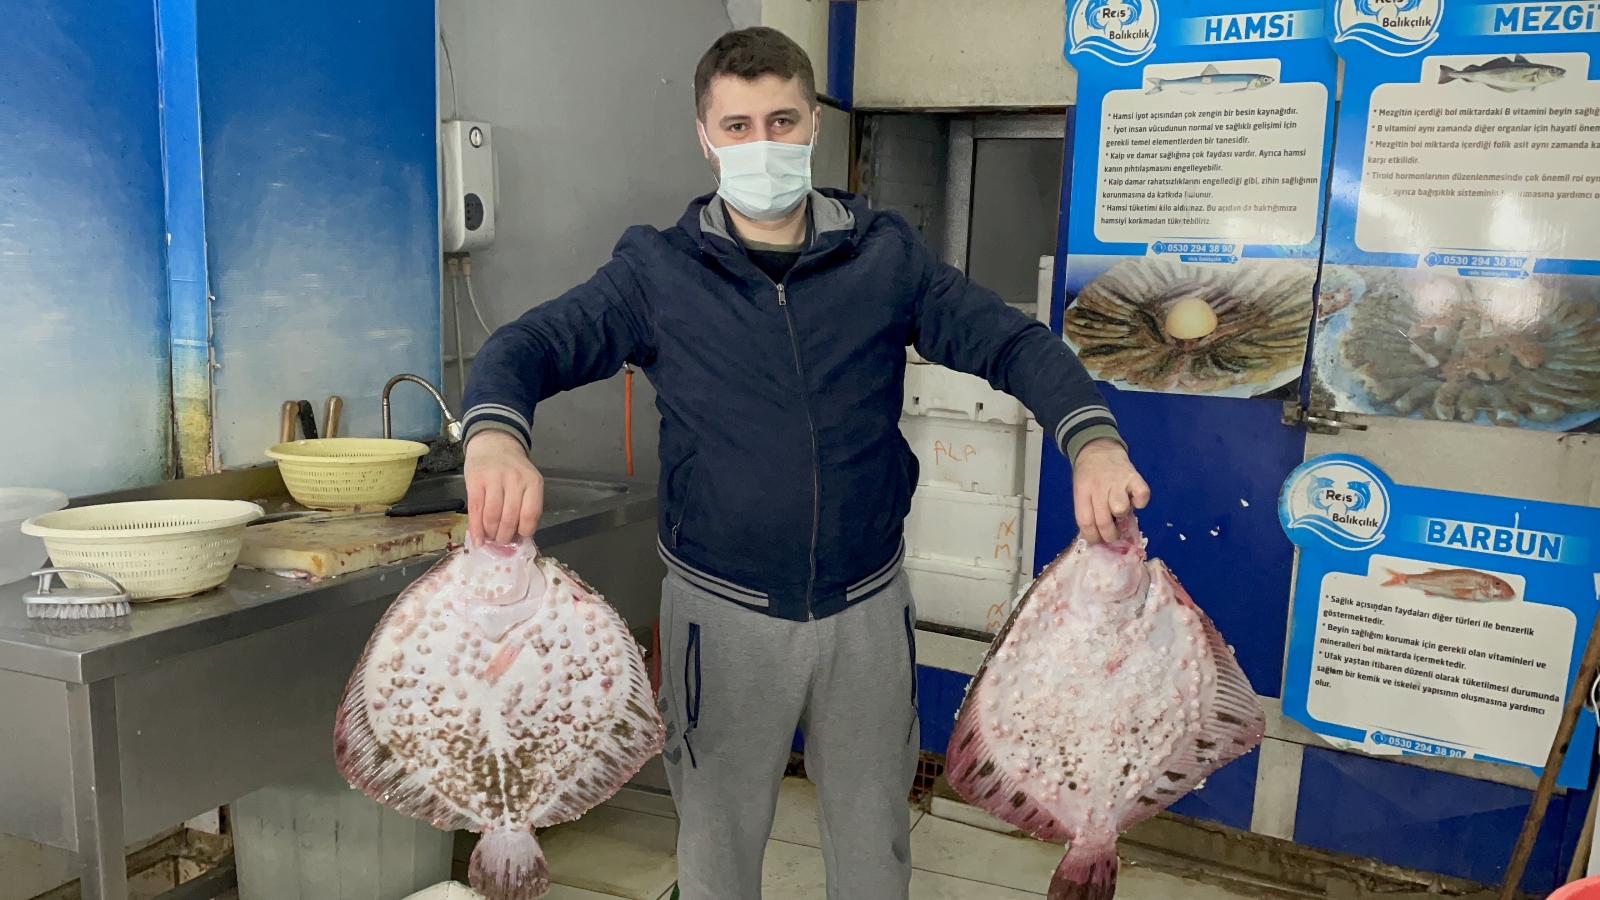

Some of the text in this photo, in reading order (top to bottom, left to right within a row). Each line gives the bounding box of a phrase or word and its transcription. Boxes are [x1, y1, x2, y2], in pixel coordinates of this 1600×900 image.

[1102, 8, 1126, 19] Reis
[1494, 5, 1600, 32] MEZGi
[1382, 18, 1432, 28] Balıkçılık
[1109, 30, 1150, 40] Balıkçılık
[1135, 112, 1148, 120] iyot
[1150, 112, 1182, 120] açısından
[1185, 111, 1196, 119] çok
[1199, 110, 1222, 118] zengin
[1379, 109, 1412, 117] Mezgitin
[1549, 107, 1572, 116] beyin
[1474, 125, 1495, 133] diğer
[1497, 124, 1532, 133] organlar
[1550, 124, 1576, 133] hayati
[1106, 139, 1129, 147] gerekli
[1375, 141, 1408, 149] Mezgitin
[1531, 142, 1549, 150] aynı
[1110, 152, 1125, 160] Kalp
[1192, 151, 1204, 159] çok
[1259, 149, 1281, 158] Ayrıca
[1525, 174, 1539, 182] çok
[1572, 174, 1583, 182] rol
[1101, 217, 1126, 225] hamsiyi
[1168, 244, 1188, 252] 0530
[1191, 244, 1206, 252] 294
[1444, 256, 1468, 264] 0530
[1471, 257, 1490, 265] 294
[1494, 258, 1506, 266] 38
[1326, 490, 1352, 503] Reis
[1333, 513, 1378, 528] Balıkçılık
[1427, 520, 1562, 560] BARBUN
[1323, 610, 1385, 625] göstermektedir.
[1331, 596, 1353, 605] Sağlık
[1395, 606, 1429, 618] faydaları
[1432, 612, 1453, 622] diğer
[1456, 617, 1481, 627] türleri
[1483, 621, 1493, 629] ile
[1495, 623, 1534, 636] benzerlik
[1328, 624, 1349, 634] Beyin
[1386, 634, 1420, 646] korumak
[1422, 640, 1436, 649] için
[1438, 644, 1466, 654] gerekli
[1468, 649, 1486, 658] olan
[1488, 652, 1534, 666] vitaminleri
[1320, 637, 1466, 670] mineralleri bol miktarda içermektedir.
[1324, 652, 1560, 702] Ufak yaştan itibaren düzenli olarak tüketilmesi durumunda
[1315, 679, 1331, 688] olur.
[1345, 670, 1355, 678] bir
[1357, 673, 1380, 683] kemik
[1383, 678, 1392, 686] ve
[1461, 692, 1507, 707] oluşmasına
[1509, 702, 1545, 715] yardımcı
[1389, 737, 1411, 748] 0530
[1414, 744, 1432, 752] 294
[1435, 747, 1446, 755] 38
